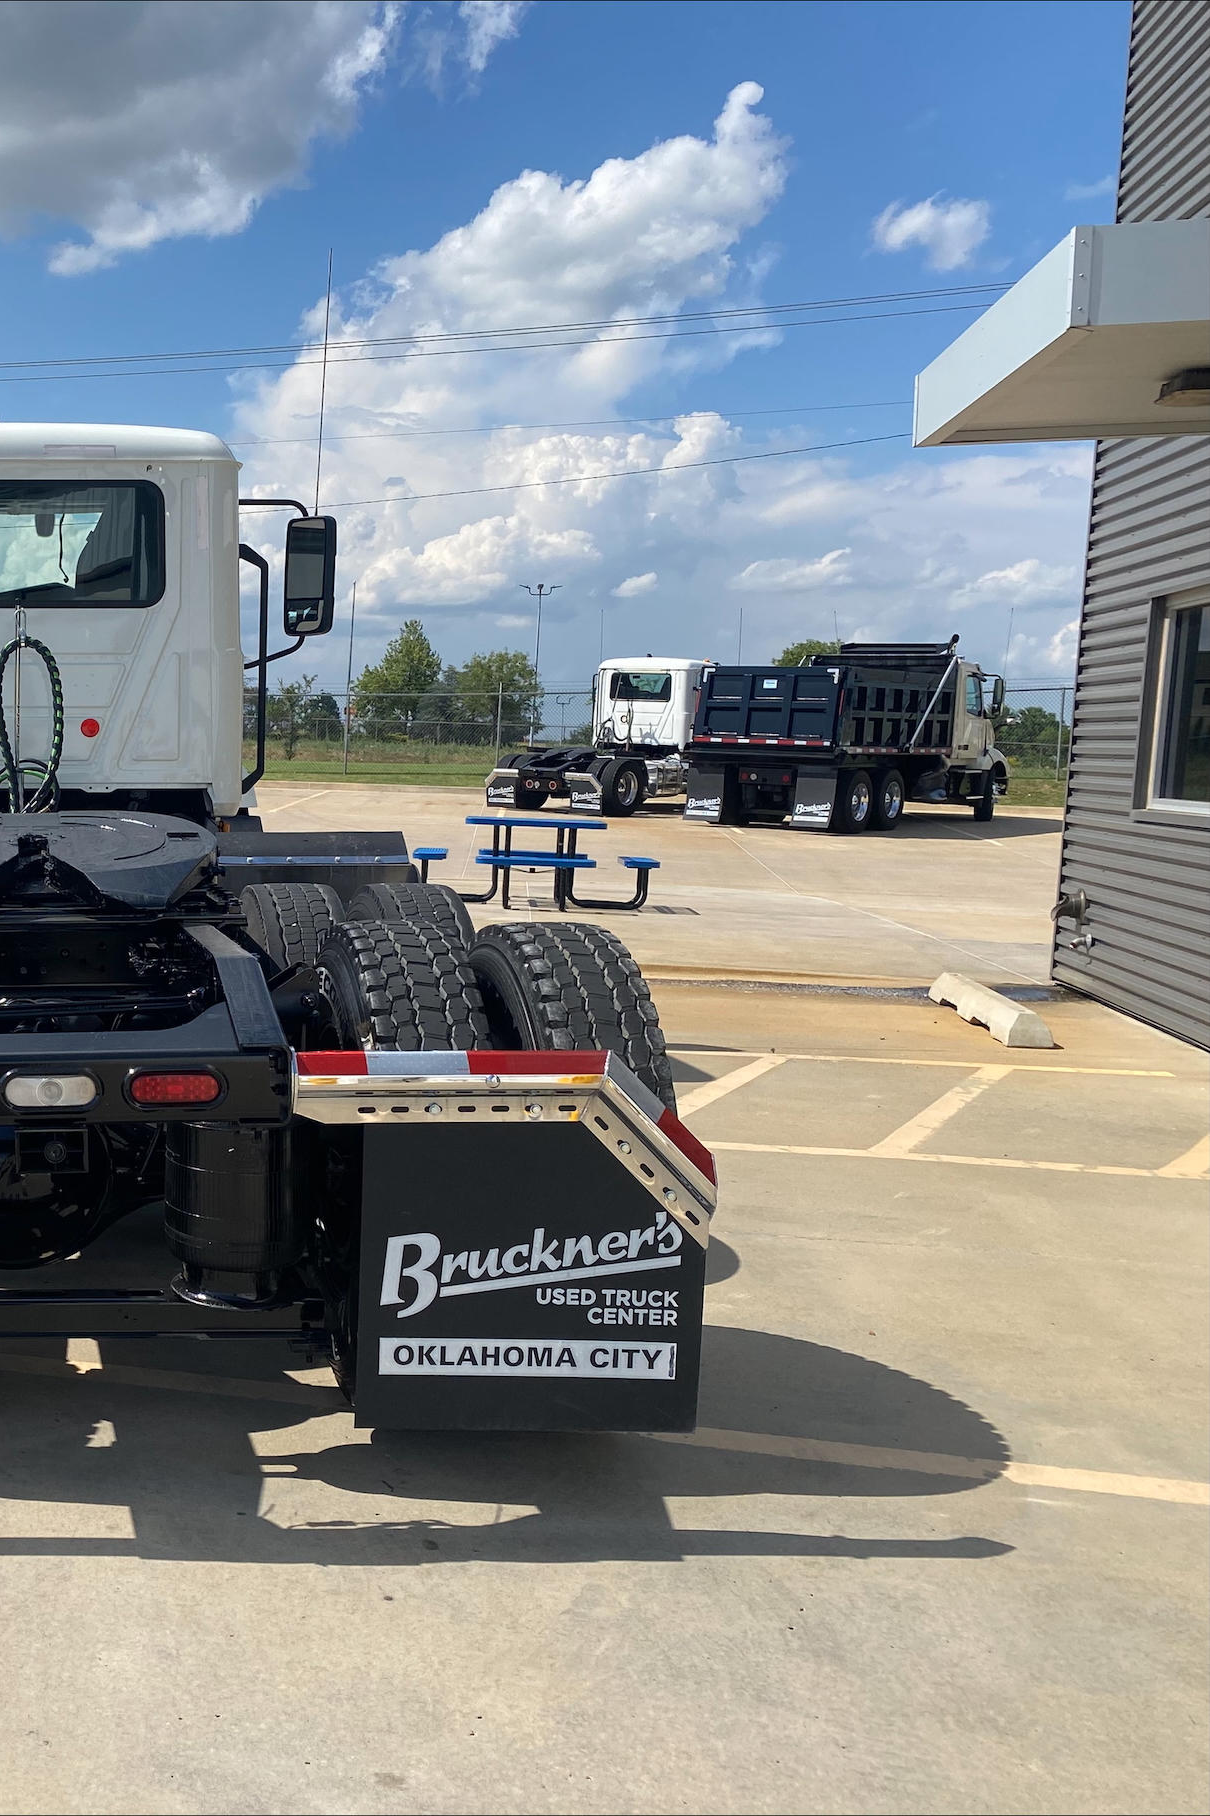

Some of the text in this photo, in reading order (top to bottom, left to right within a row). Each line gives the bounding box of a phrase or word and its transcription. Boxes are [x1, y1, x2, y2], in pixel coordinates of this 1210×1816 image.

[379, 1211, 684, 1319] Bruckner's
[535, 1287, 679, 1308] USED TRUCK
[587, 1307, 678, 1327] CENTER
[392, 1344, 663, 1370] OKLAHOMA CITY
